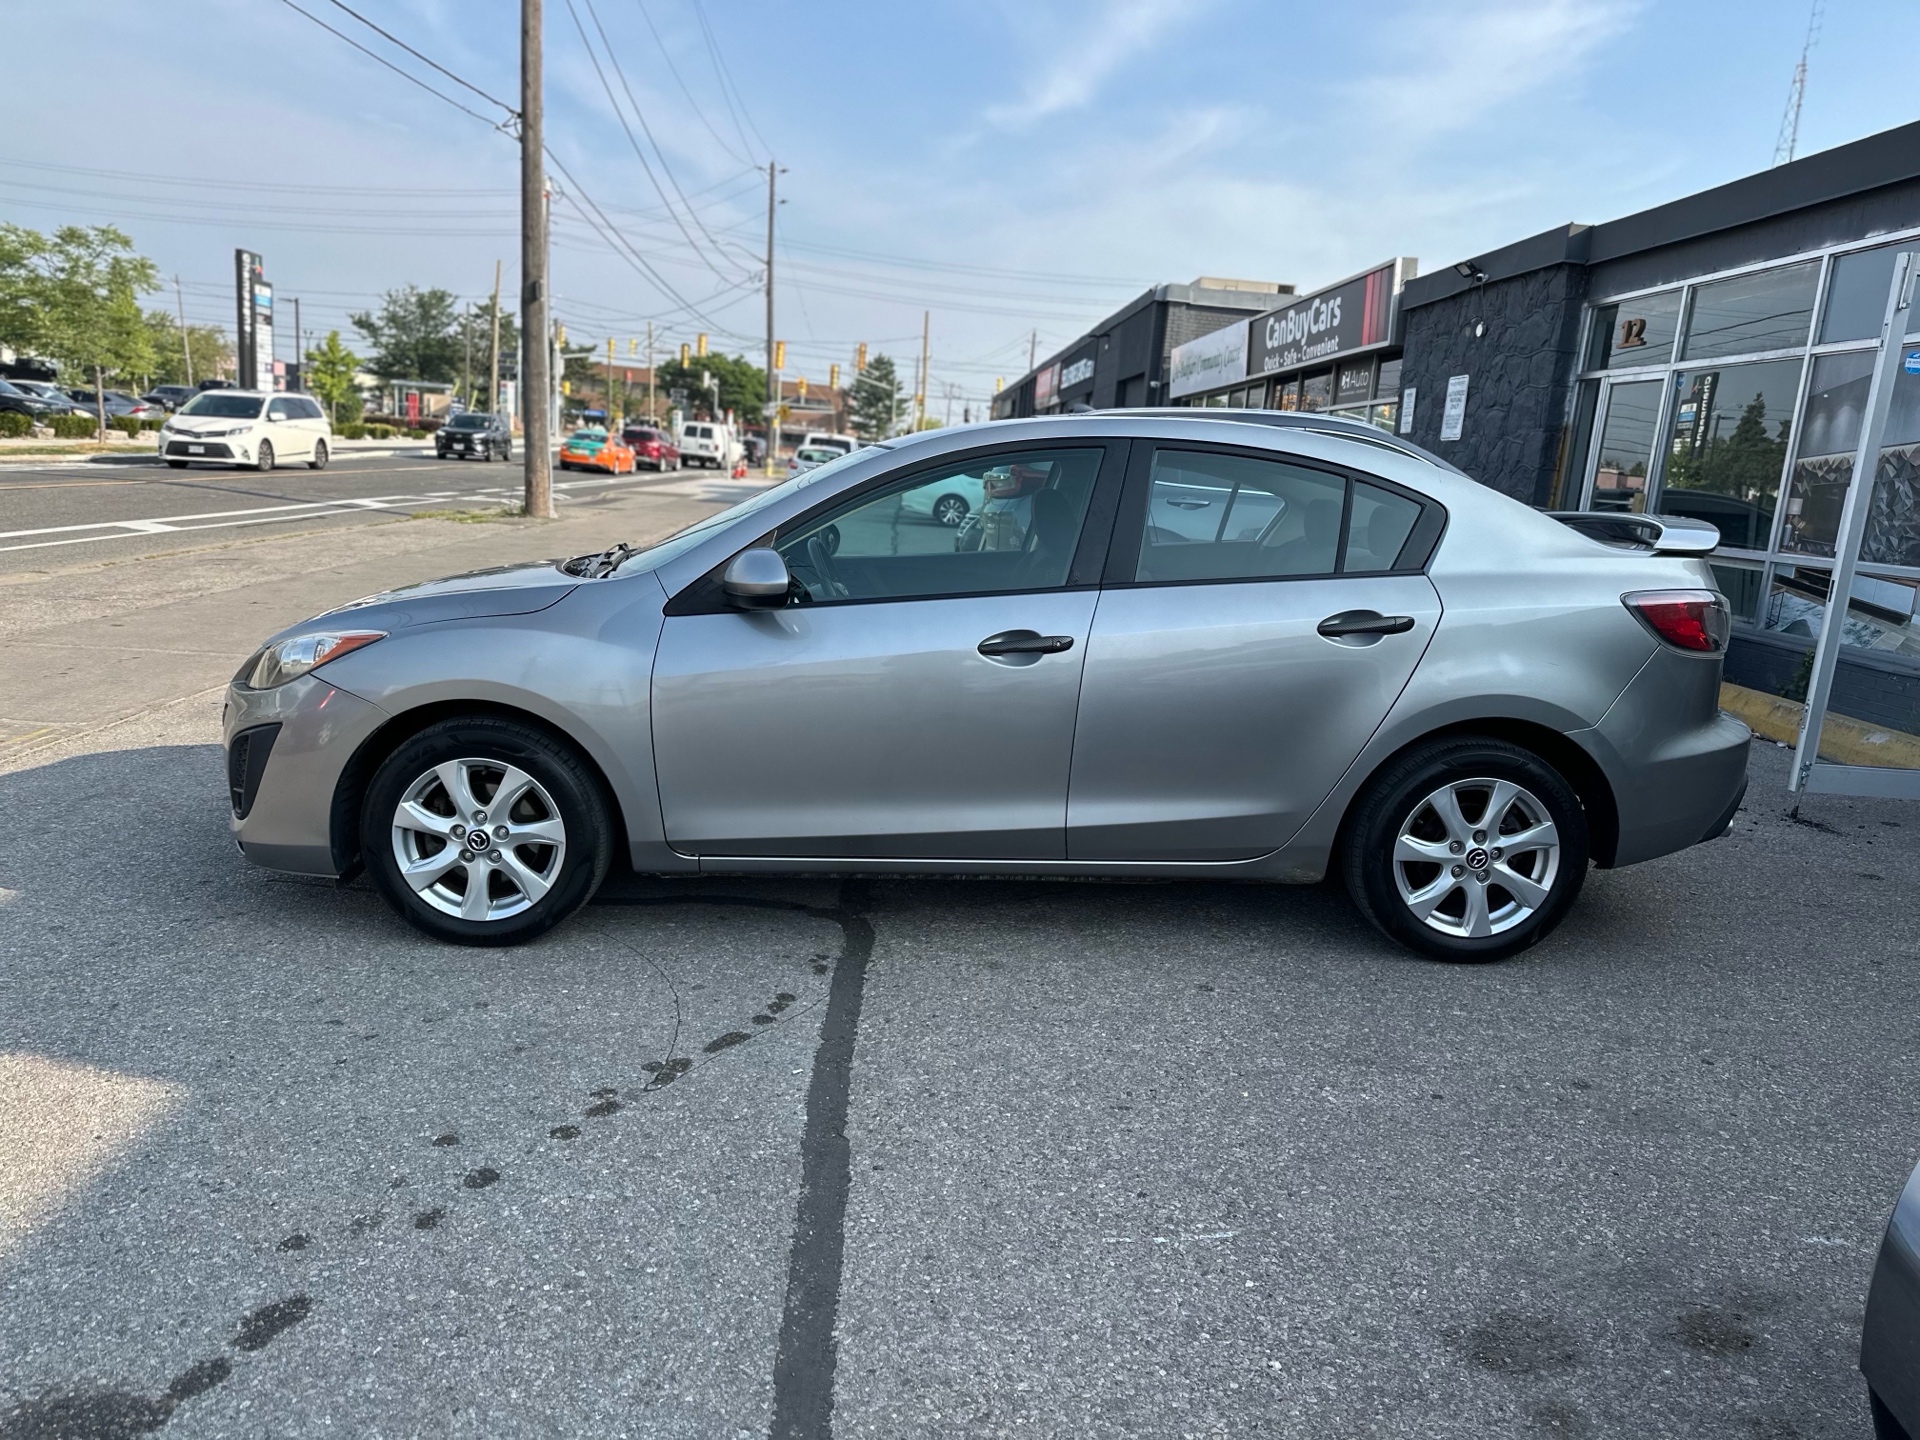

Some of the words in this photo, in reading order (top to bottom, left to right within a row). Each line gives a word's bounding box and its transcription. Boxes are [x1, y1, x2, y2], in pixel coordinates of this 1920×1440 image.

[1265, 296, 1342, 350] CanBuyCars
[1616, 318, 1647, 349] 12
[1263, 353, 1280, 372] Quick
[1284, 348, 1297, 367] Safe
[1302, 335, 1339, 361] Convenient
